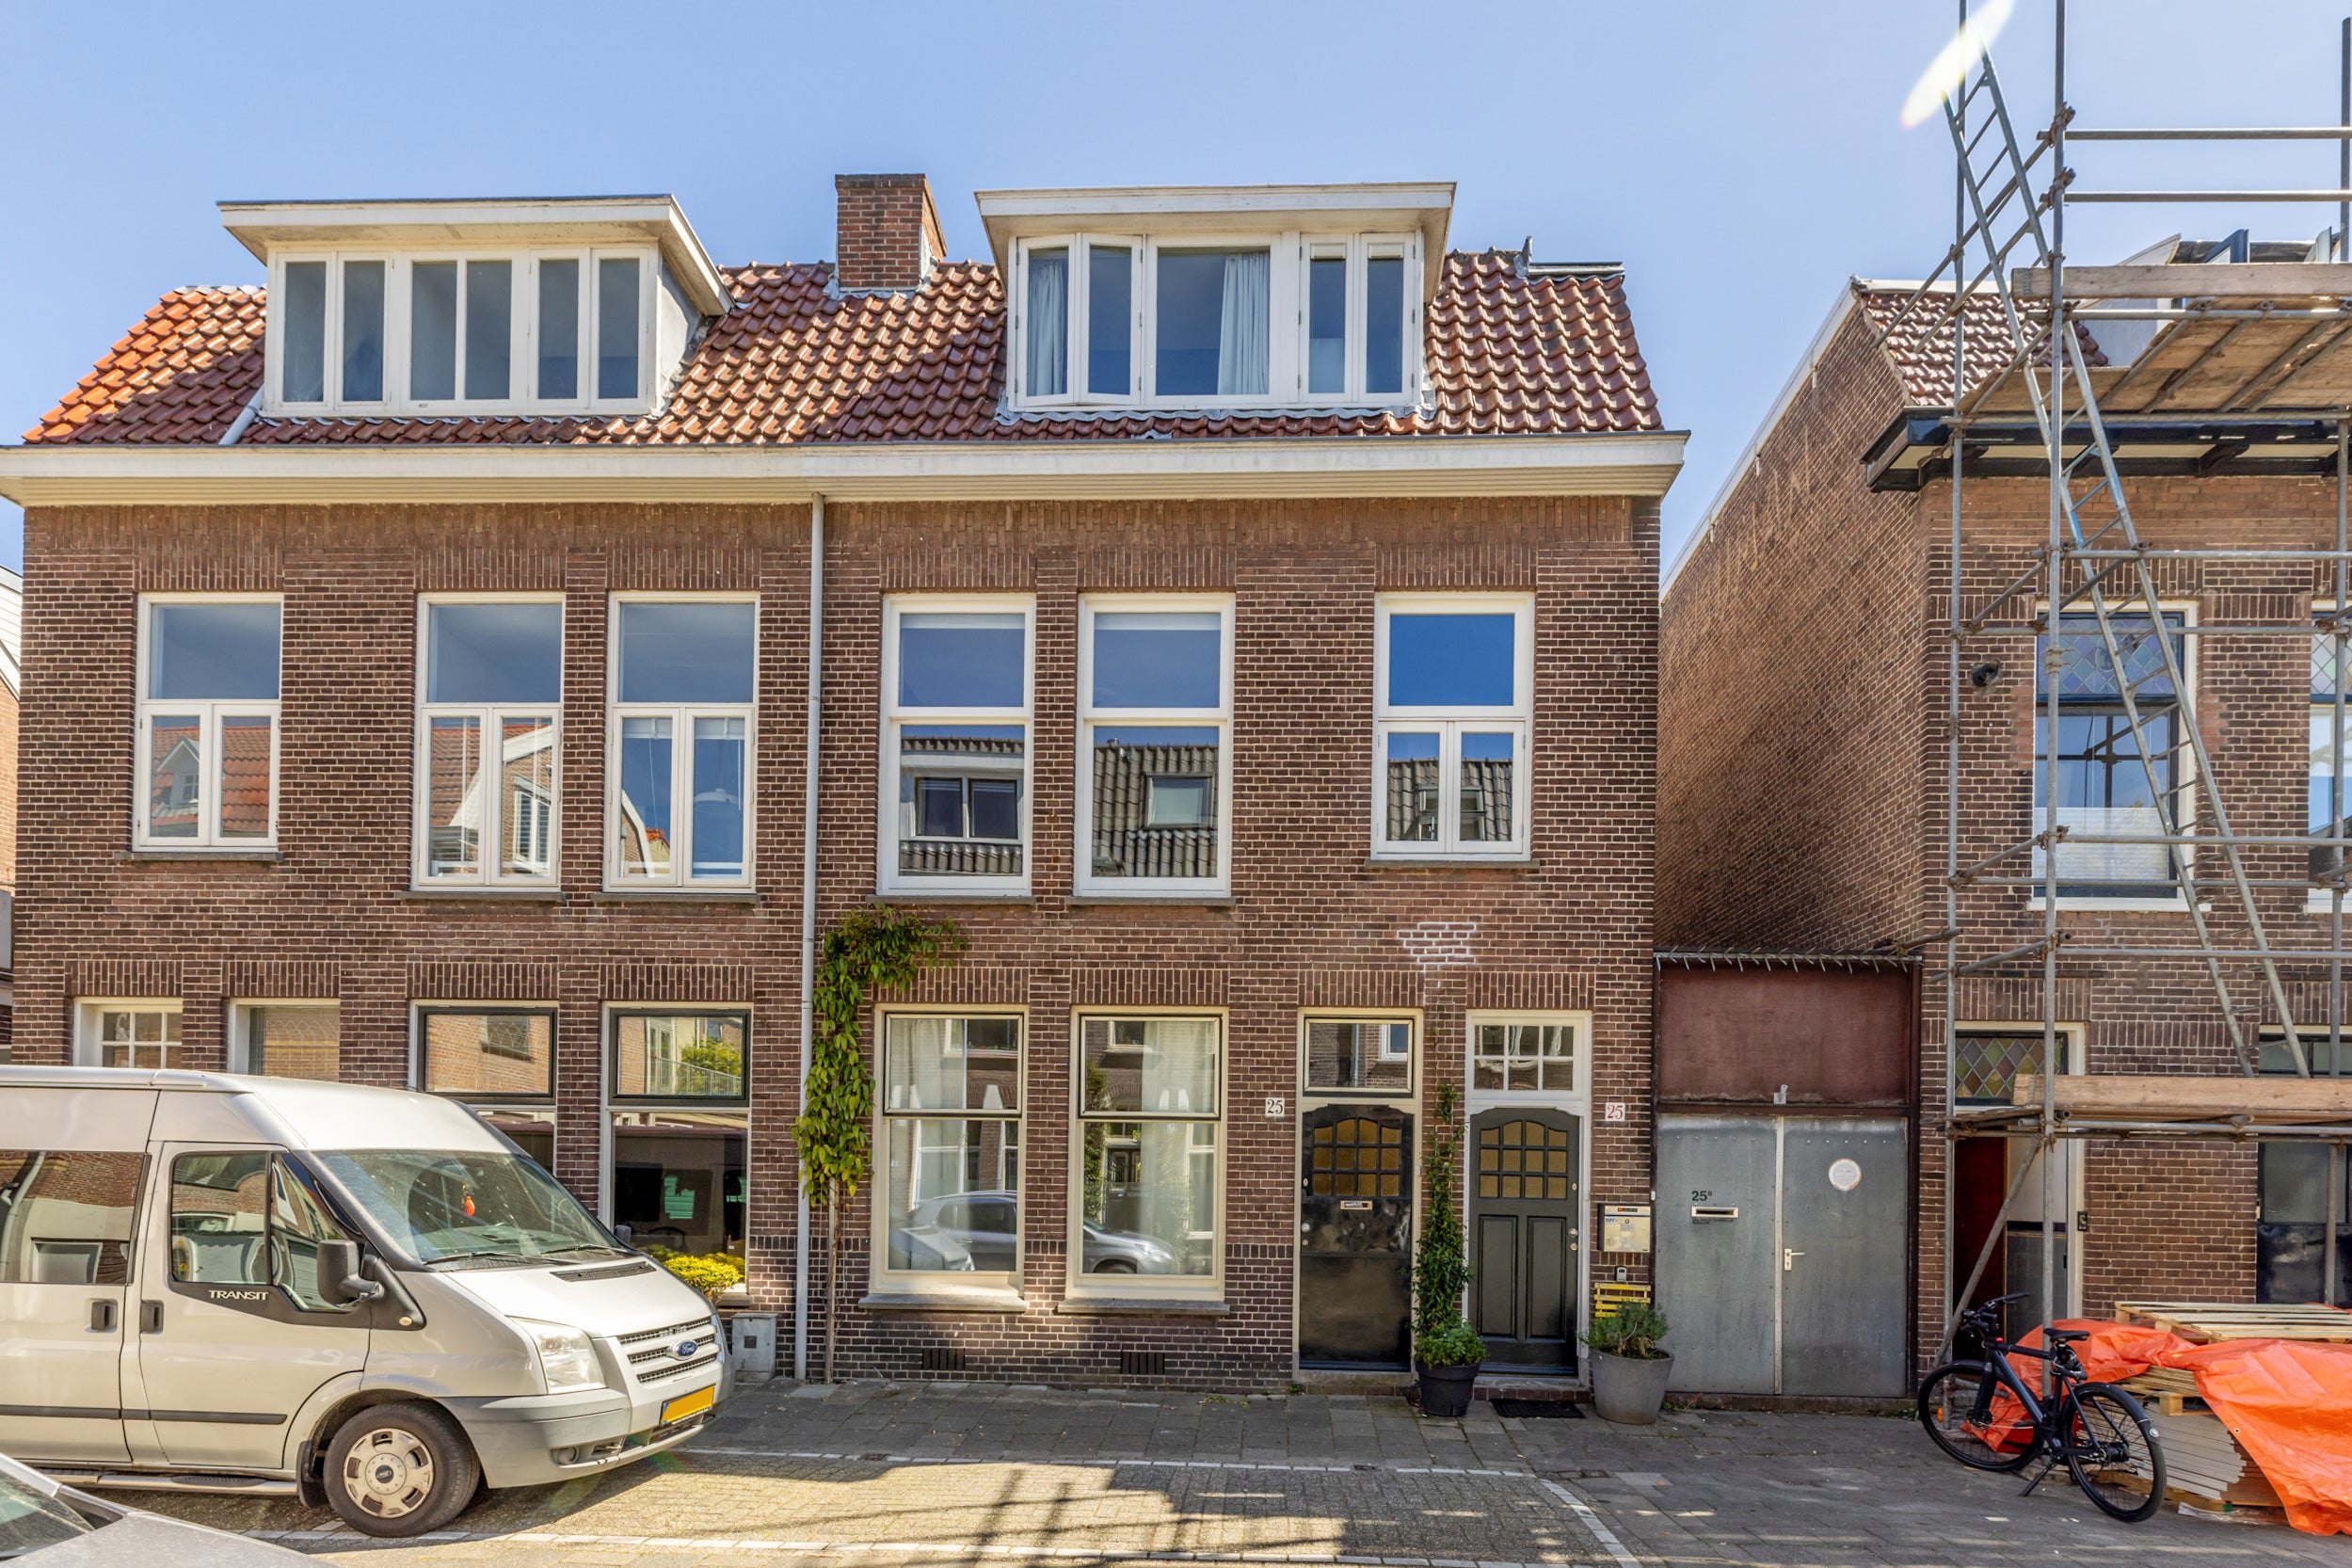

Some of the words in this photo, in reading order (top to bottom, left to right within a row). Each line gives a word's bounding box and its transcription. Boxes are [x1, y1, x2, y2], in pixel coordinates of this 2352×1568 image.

[1267, 1098, 1284, 1114] 25
[1607, 1105, 1624, 1120] 25
[208, 1289, 269, 1301] TRANSIT
